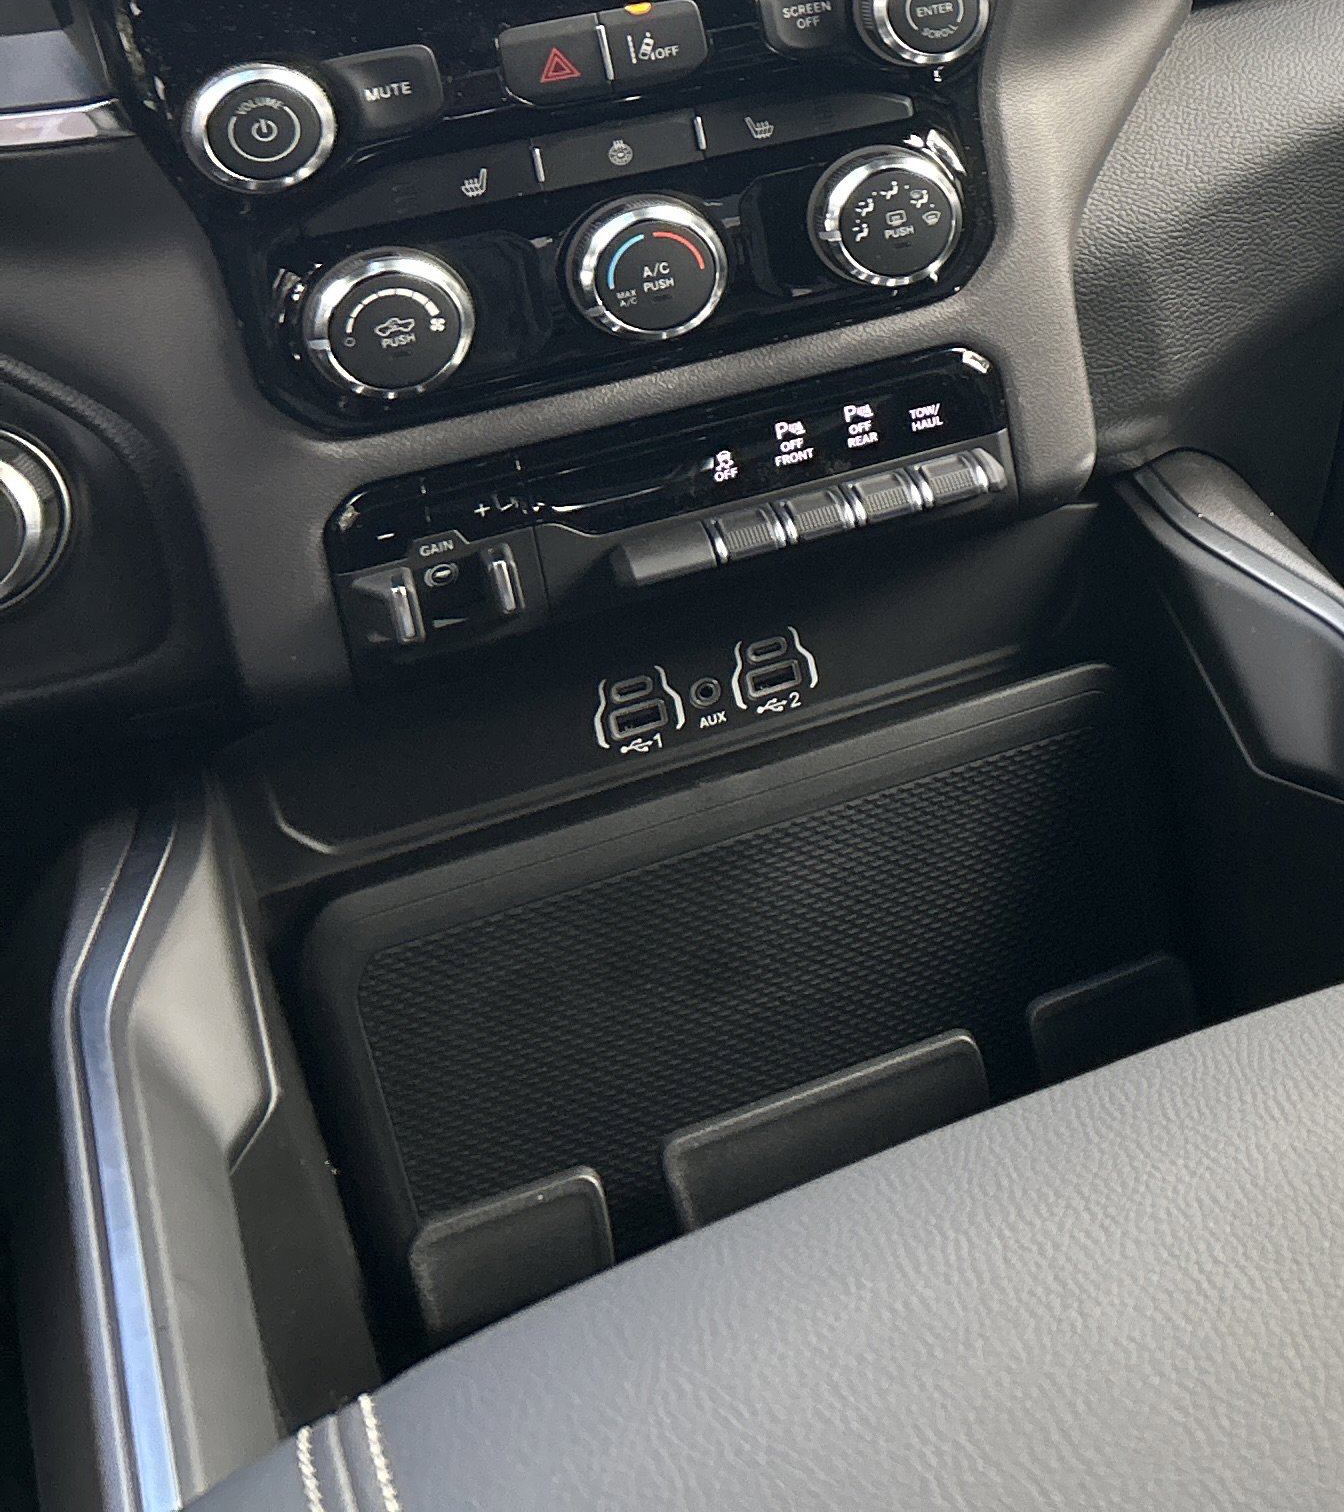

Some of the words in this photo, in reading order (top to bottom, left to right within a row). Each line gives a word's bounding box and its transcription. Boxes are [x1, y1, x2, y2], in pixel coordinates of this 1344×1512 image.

[782, 0, 832, 19] SCREEN
[916, 2, 954, 18] ENTER
[796, 16, 821, 29] OFF
[921, 23, 959, 39] SCROLL
[654, 45, 680, 60] OFF
[364, 81, 412, 102] MUTE
[235, 96, 285, 115] VOLUME
[884, 226, 915, 239] PUSH
[642, 262, 670, 278] A/C
[643, 277, 675, 292] PUSH
[616, 289, 637, 300] MAX
[619, 296, 638, 307] A/C
[380, 330, 418, 348] PUSH
[909, 403, 941, 419] TOW/
[848, 420, 872, 435] OFF
[912, 416, 944, 432] HAUL
[780, 438, 804, 453] OFF
[848, 432, 878, 448] REAR
[775, 448, 814, 467] FRONT
[714, 467, 738, 482] OFF
[419, 540, 454, 557] GAIN
[789, 692, 801, 708] 2
[700, 711, 727, 729] AUX
[653, 733, 662, 748] 1
